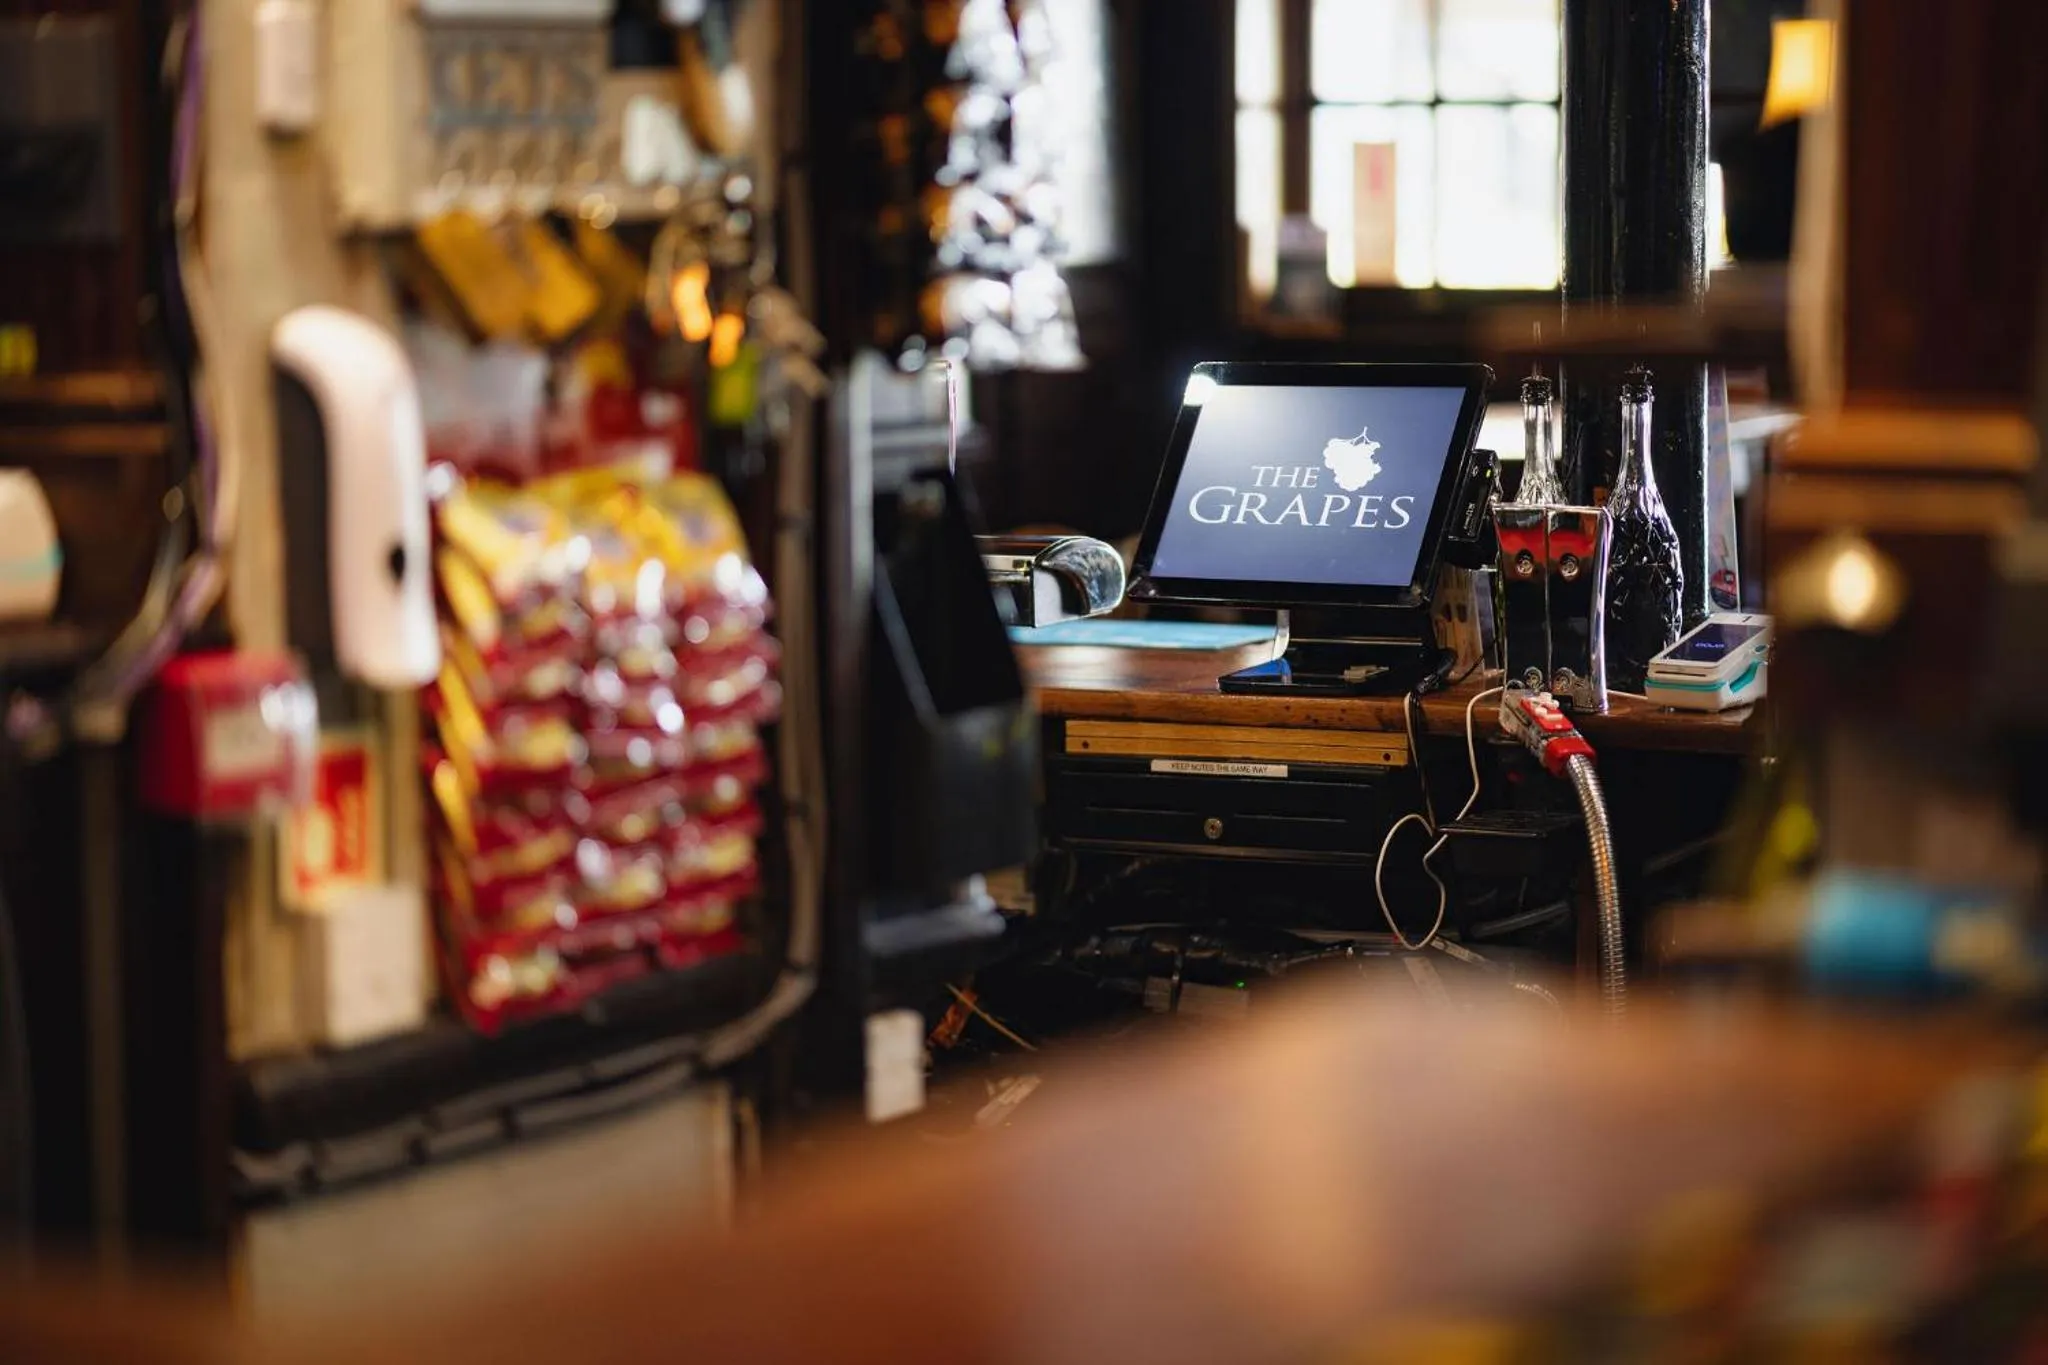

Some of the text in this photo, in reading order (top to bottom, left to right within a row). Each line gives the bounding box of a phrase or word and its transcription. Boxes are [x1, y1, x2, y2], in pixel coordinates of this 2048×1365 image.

[1251, 465, 1321, 489] THE
[1188, 485, 1416, 530] GRAPES
[1252, 766, 1268, 774] WAY
